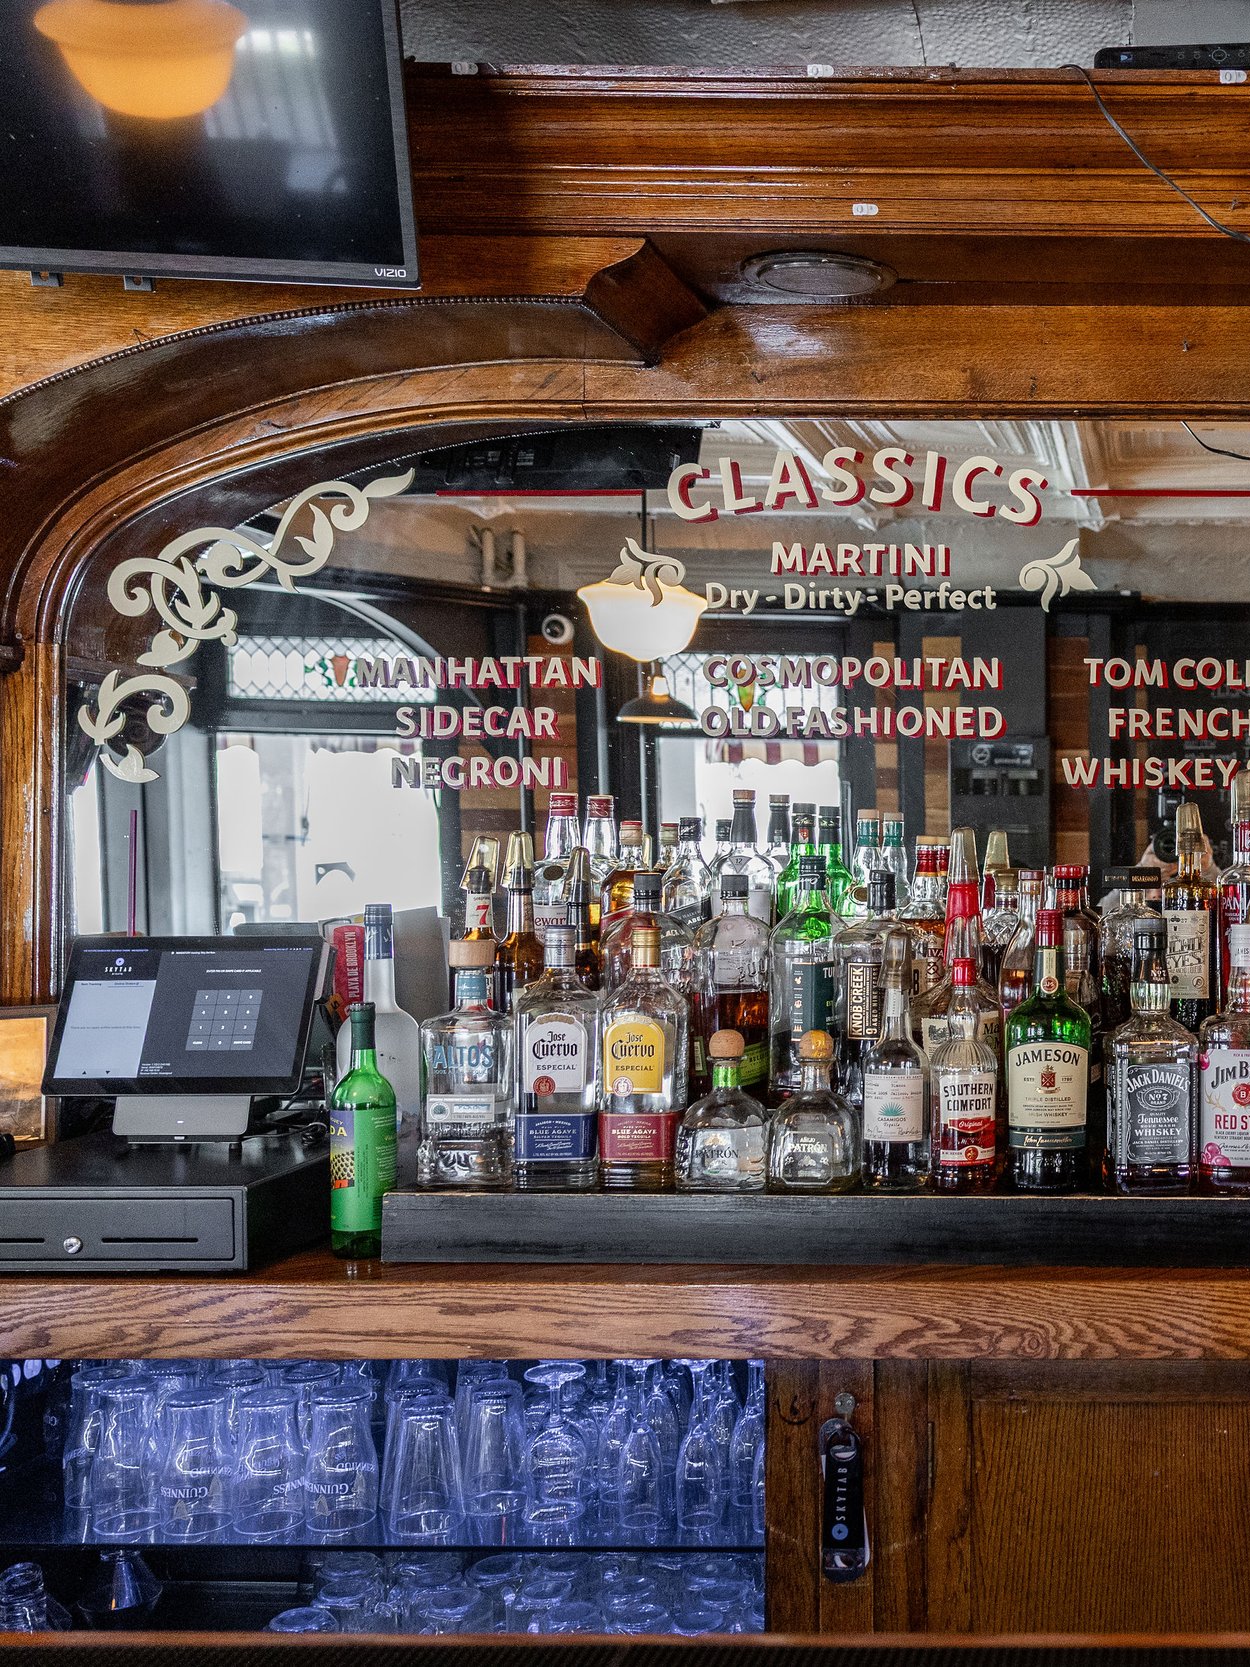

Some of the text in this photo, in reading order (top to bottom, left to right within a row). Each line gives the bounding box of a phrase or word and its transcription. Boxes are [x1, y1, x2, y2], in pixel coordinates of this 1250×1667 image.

[374, 268, 407, 278] VIZIO
[667, 447, 1048, 527] CLASSICS
[770, 542, 951, 576] MARTINI
[706, 581, 997, 616] Dry Dirty Perfect
[356, 656, 600, 688] MANHATTAN
[702, 656, 1002, 690] COSMOPOLITAN
[1084, 657, 1168, 689] TOM
[395, 706, 559, 739] SIDECAR
[700, 706, 1007, 738] OLD FASHIONED
[391, 756, 568, 789] NEGRONI
[1062, 756, 1237, 789] WHISKEY
[475, 904, 490, 925] 7
[344, 931, 358, 966] BROOKLYN
[348, 977, 360, 998] PLAYA
[852, 966, 864, 1035] KNOB CREEK
[548, 1031, 567, 1043] Jose
[626, 1031, 644, 1043] Jose
[432, 1045, 494, 1069] ALTOS
[532, 1040, 578, 1059] Cuervo
[611, 1041, 655, 1059] Cuervo
[1016, 1049, 1080, 1067] JAMESON
[1126, 1069, 1191, 1093] JACK DANIEL'S
[1211, 1066, 1237, 1089] JIM
[944, 1083, 994, 1097] SOUTHERN
[947, 1098, 991, 1111] COMFORT
[959, 1121, 983, 1129] Original
[1137, 1114, 1179, 1124] Tennessee
[1215, 1114, 1237, 1130] RED
[1135, 1128, 1182, 1136] WHISKEY
[695, 1147, 739, 1159] PATRÓN
[788, 1142, 828, 1153] PATRÓN
[160, 1485, 209, 1499] GUINNESS
[304, 1482, 350, 1495] GUINNESS
[836, 1467, 848, 1521] SKYTAB
